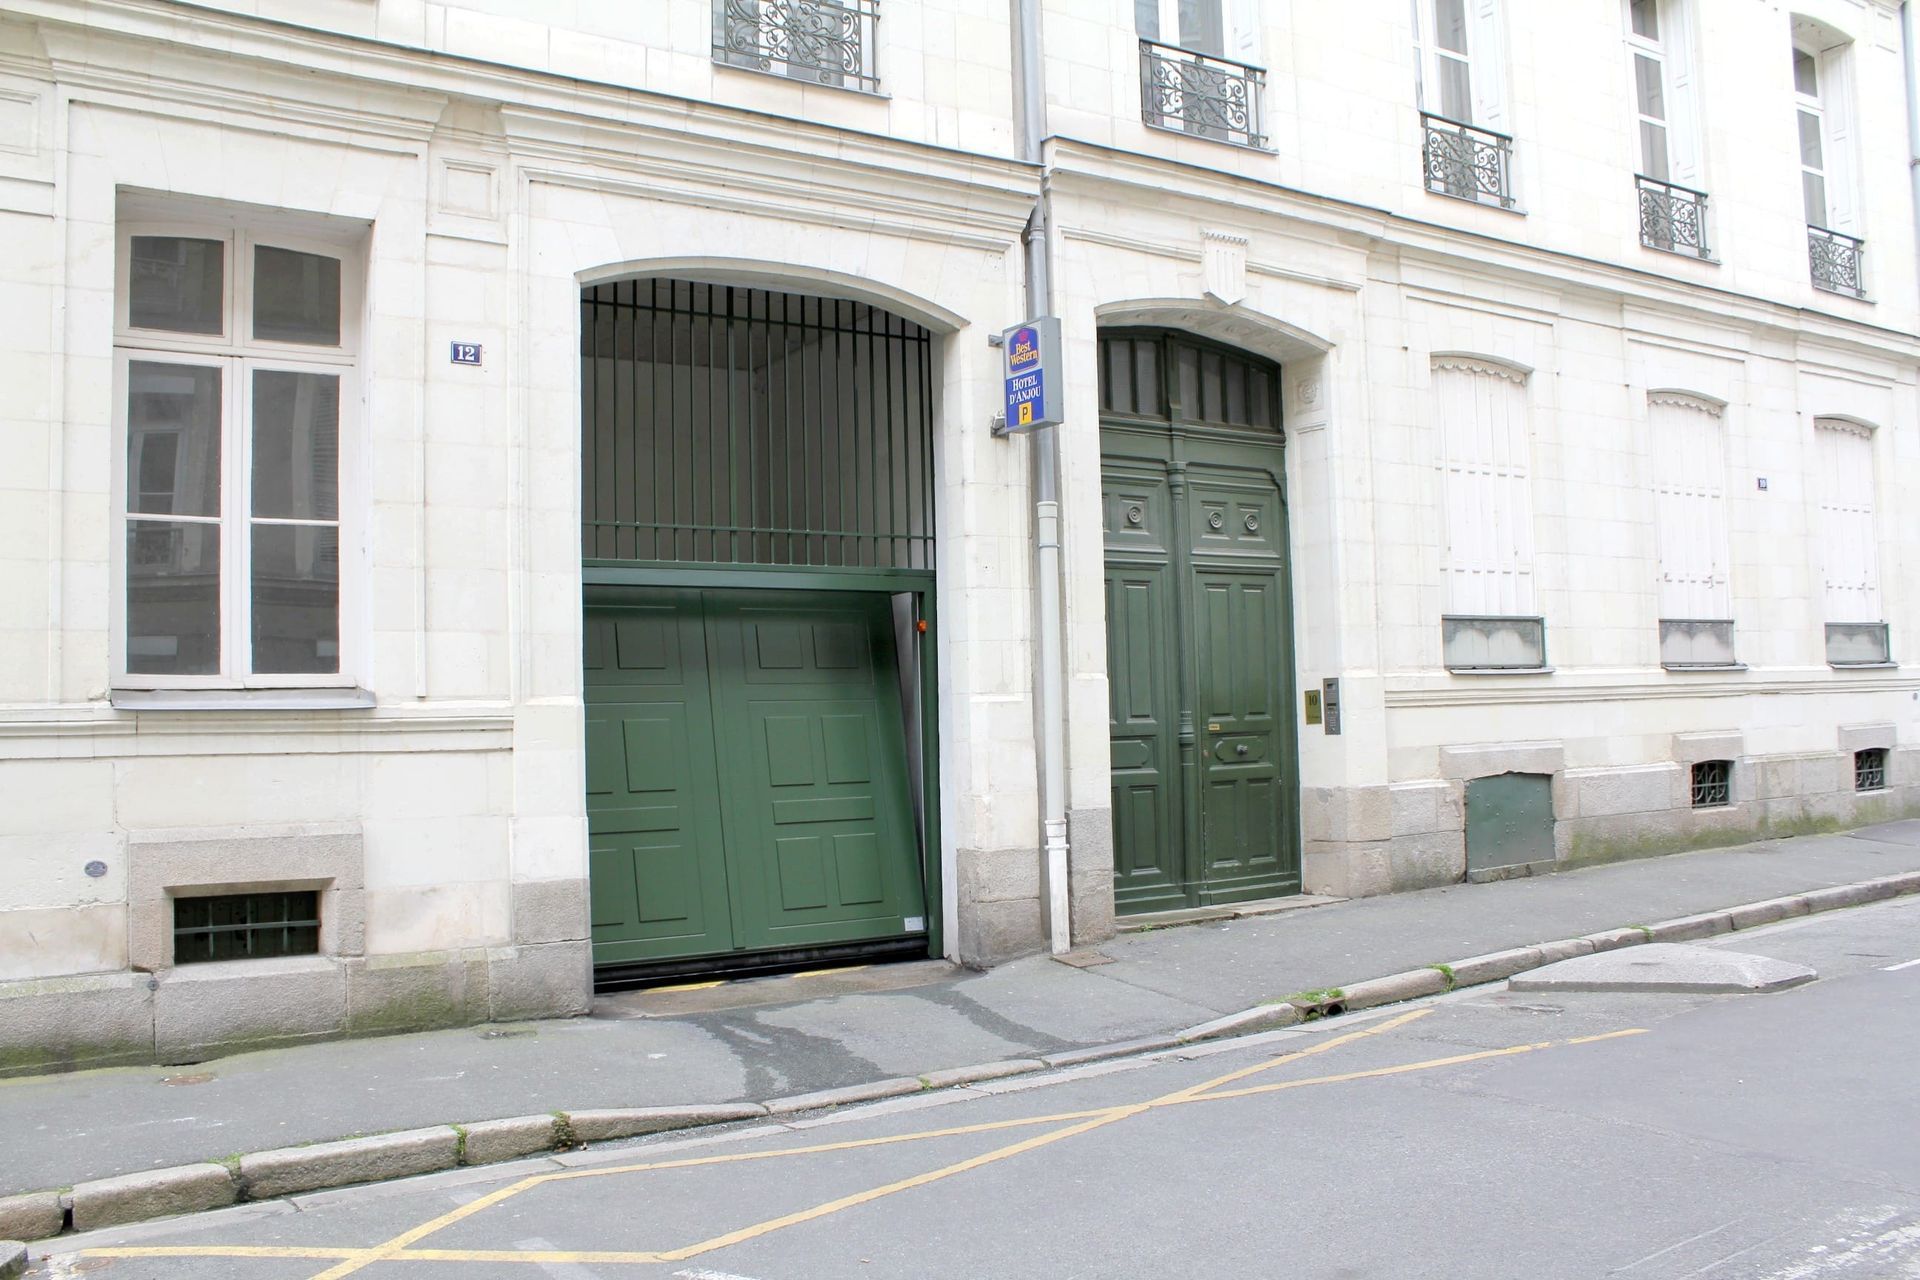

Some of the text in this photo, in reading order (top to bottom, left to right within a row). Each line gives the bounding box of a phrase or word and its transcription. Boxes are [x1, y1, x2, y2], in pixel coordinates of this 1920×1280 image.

[457, 345, 475, 361] 12
[1015, 340, 1031, 355] Best
[1010, 349, 1038, 366] Western
[1012, 375, 1038, 391] HOTEL
[1009, 385, 1041, 405] D'ANJOU
[1022, 406, 1028, 420] P
[1308, 694, 1318, 706] 10
